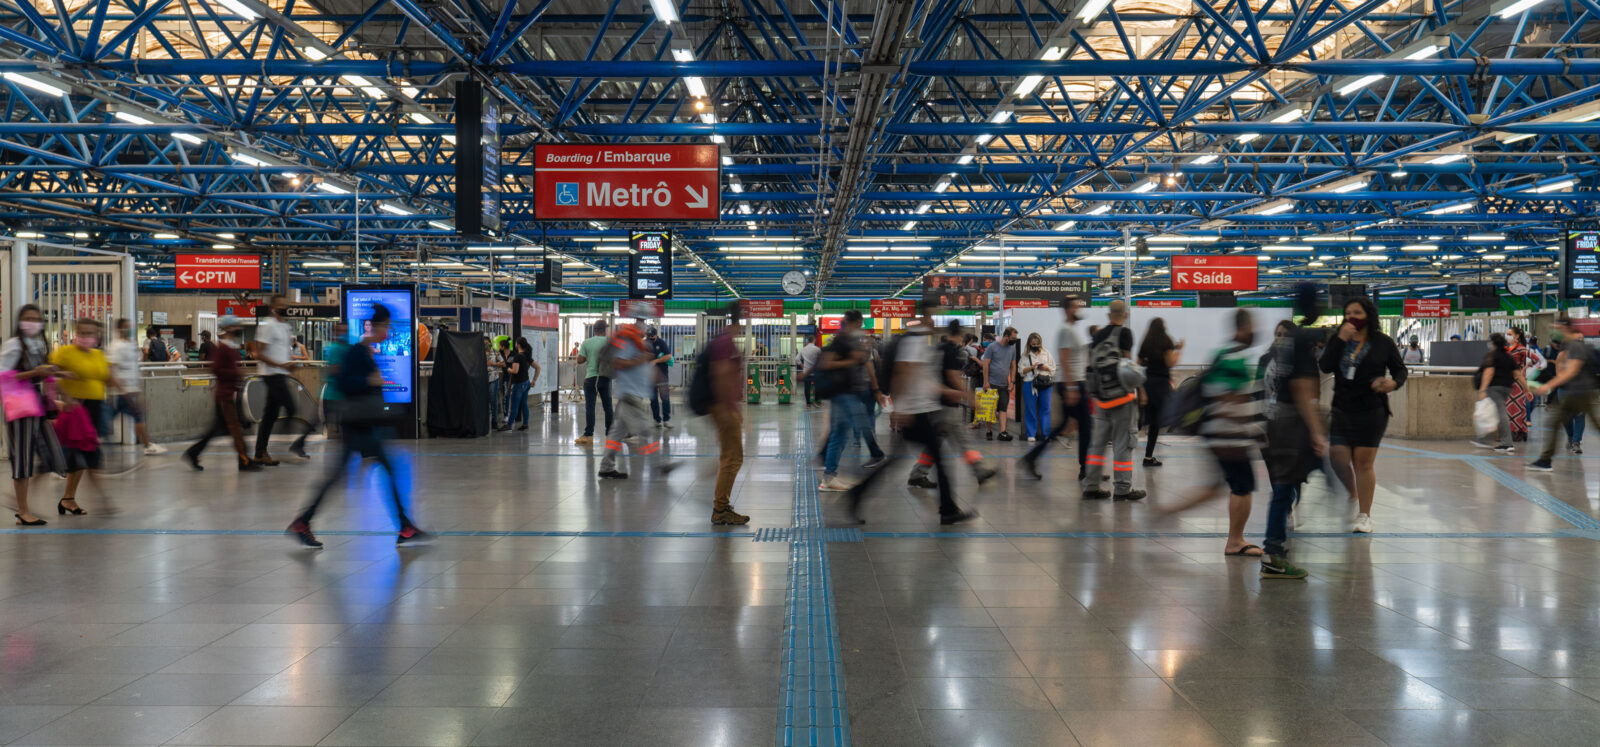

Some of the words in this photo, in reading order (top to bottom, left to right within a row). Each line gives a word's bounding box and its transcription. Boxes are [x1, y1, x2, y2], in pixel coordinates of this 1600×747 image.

[546, 153, 593, 165] Boarding
[596, 151, 602, 163] /
[604, 151, 671, 165] Embarque
[586, 181, 672, 208] Metrô
[640, 241, 661, 249] FRIDAY
[1576, 240, 1598, 249] FRIDAY
[195, 271, 236, 284] CPTM
[1192, 271, 1232, 284] Saída
[286, 308, 314, 316] CPTM
